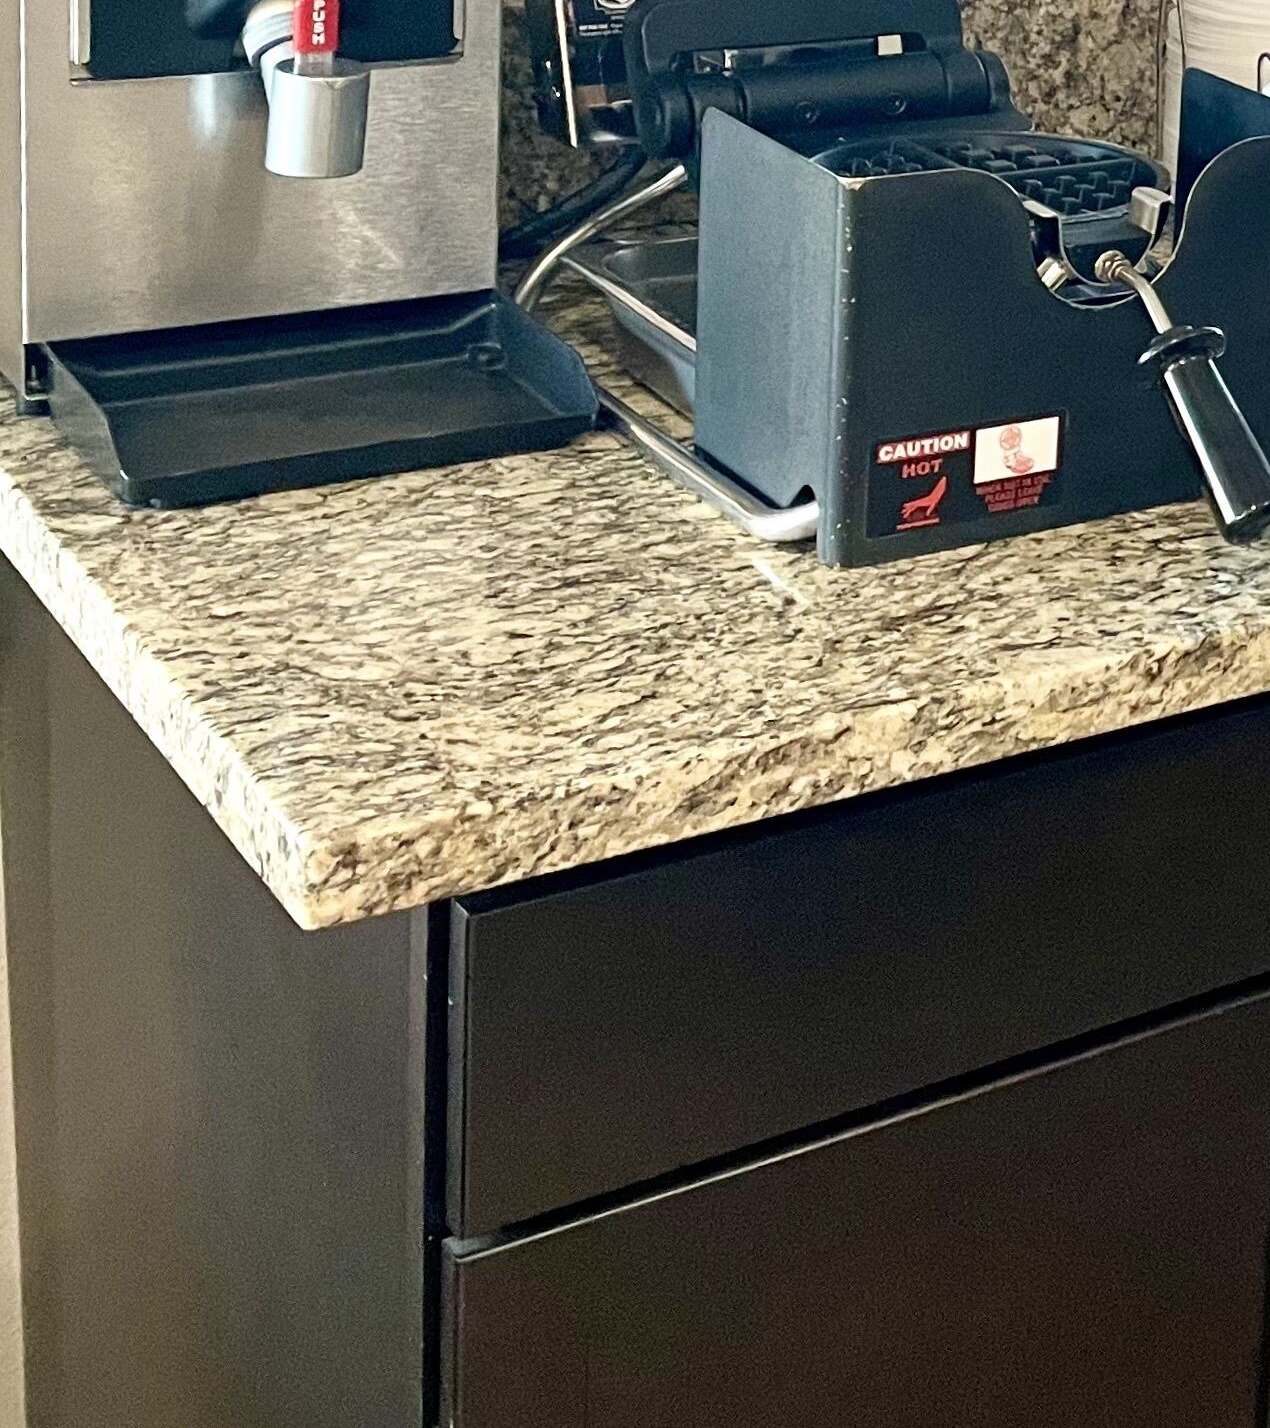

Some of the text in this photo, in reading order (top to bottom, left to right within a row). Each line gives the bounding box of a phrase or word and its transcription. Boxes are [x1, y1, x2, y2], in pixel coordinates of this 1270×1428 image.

[311, 0, 326, 46] PUSH
[878, 431, 970, 462] CAUTION
[901, 458, 943, 479] HOT
